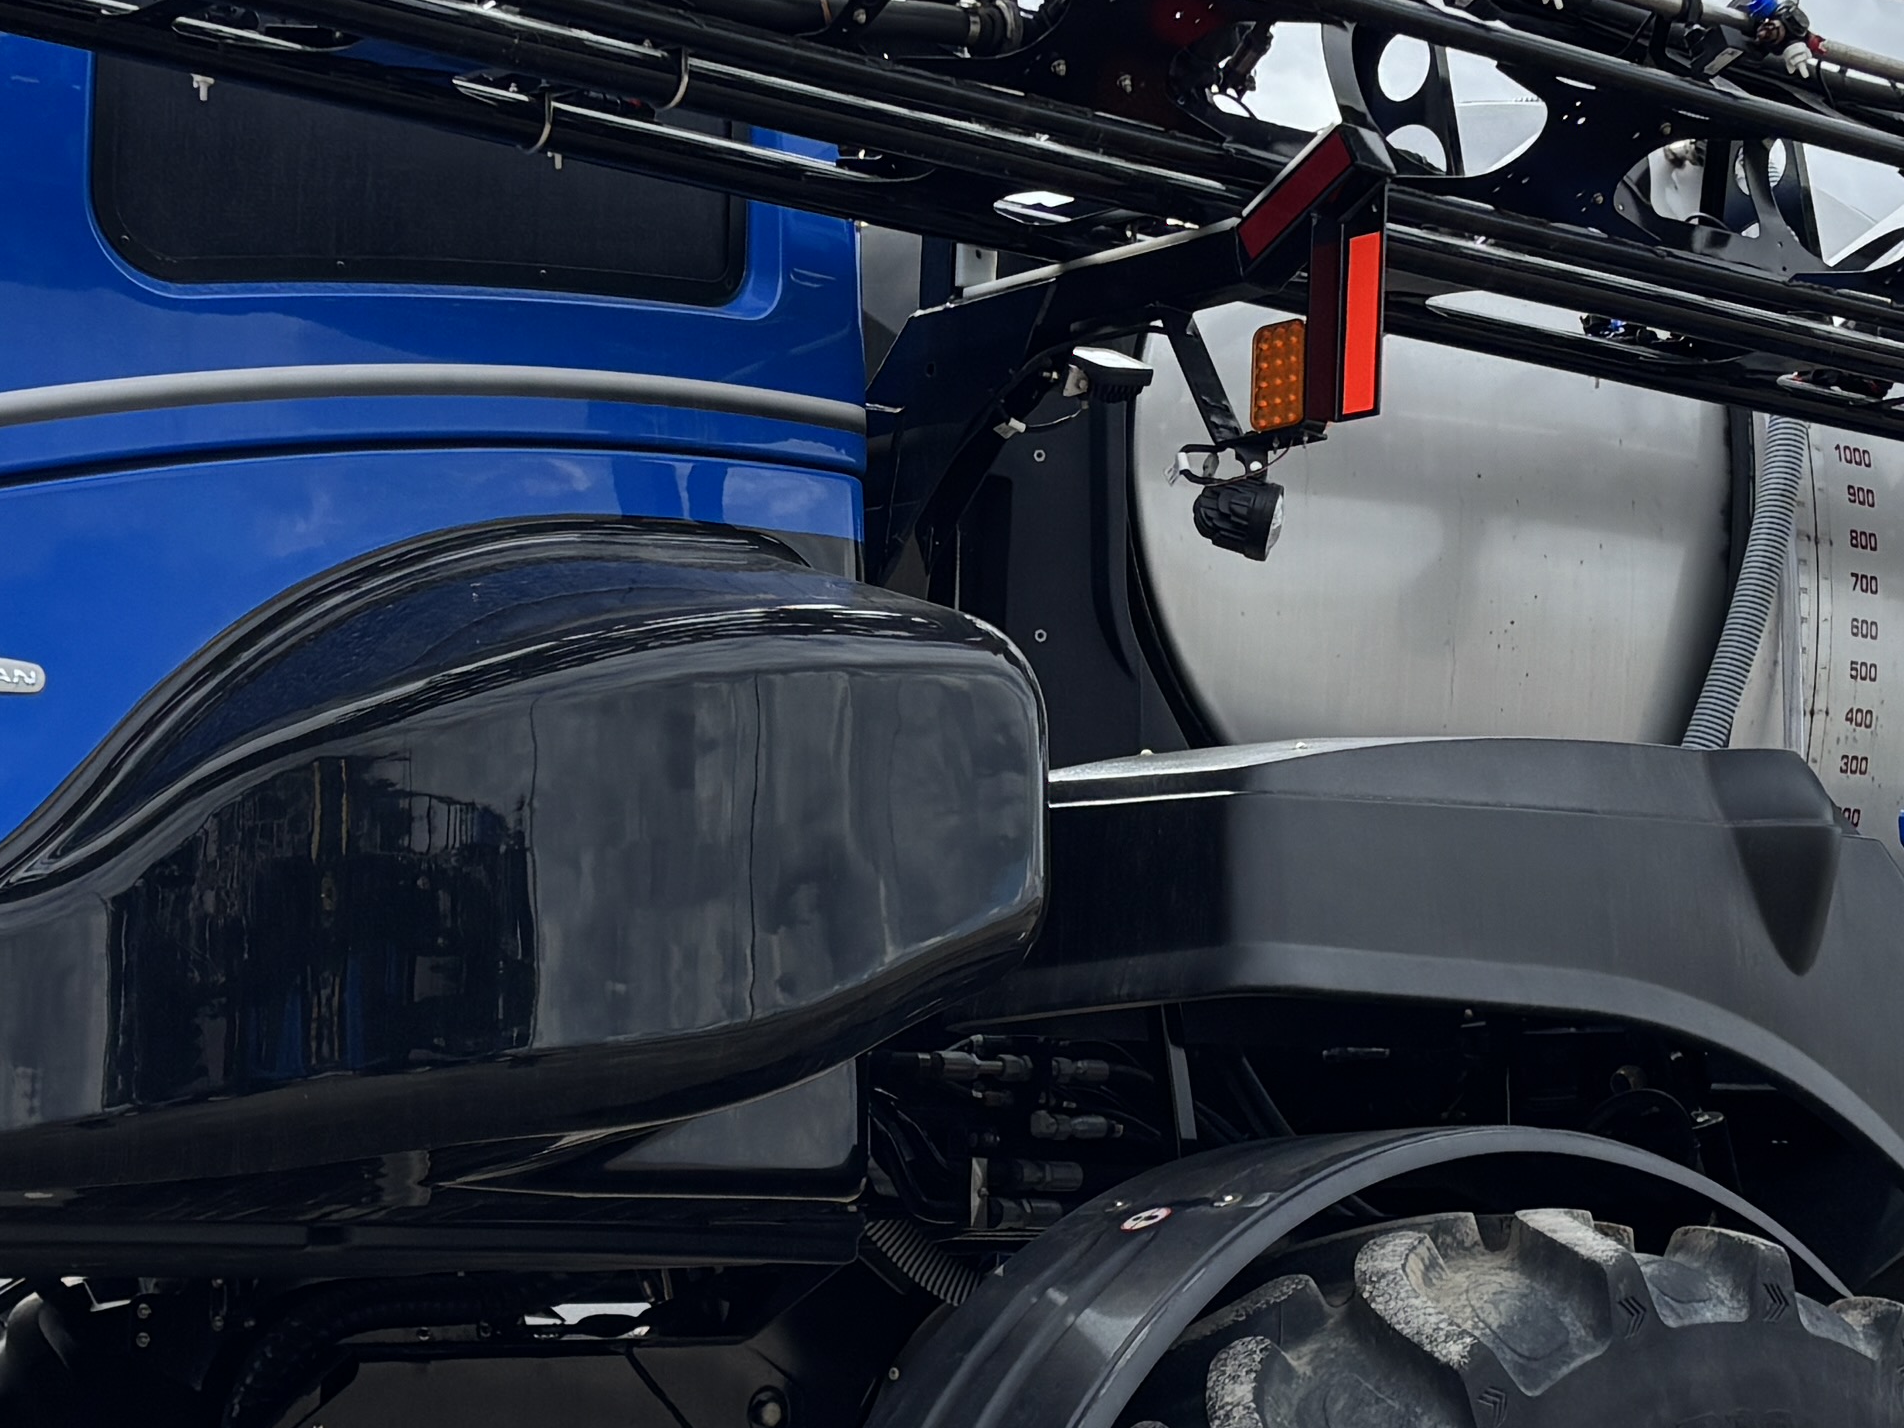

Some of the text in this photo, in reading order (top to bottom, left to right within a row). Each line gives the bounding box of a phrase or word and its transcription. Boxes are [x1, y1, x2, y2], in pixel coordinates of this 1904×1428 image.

[1834, 443, 1873, 469] 1000
[1846, 484, 1876, 509] 900
[1849, 529, 1878, 552] 800
[1850, 572, 1879, 595] 700
[1850, 617, 1879, 641] 600
[1849, 660, 1878, 683] 500
[1844, 707, 1874, 730] 400
[1839, 754, 1869, 776] 300
